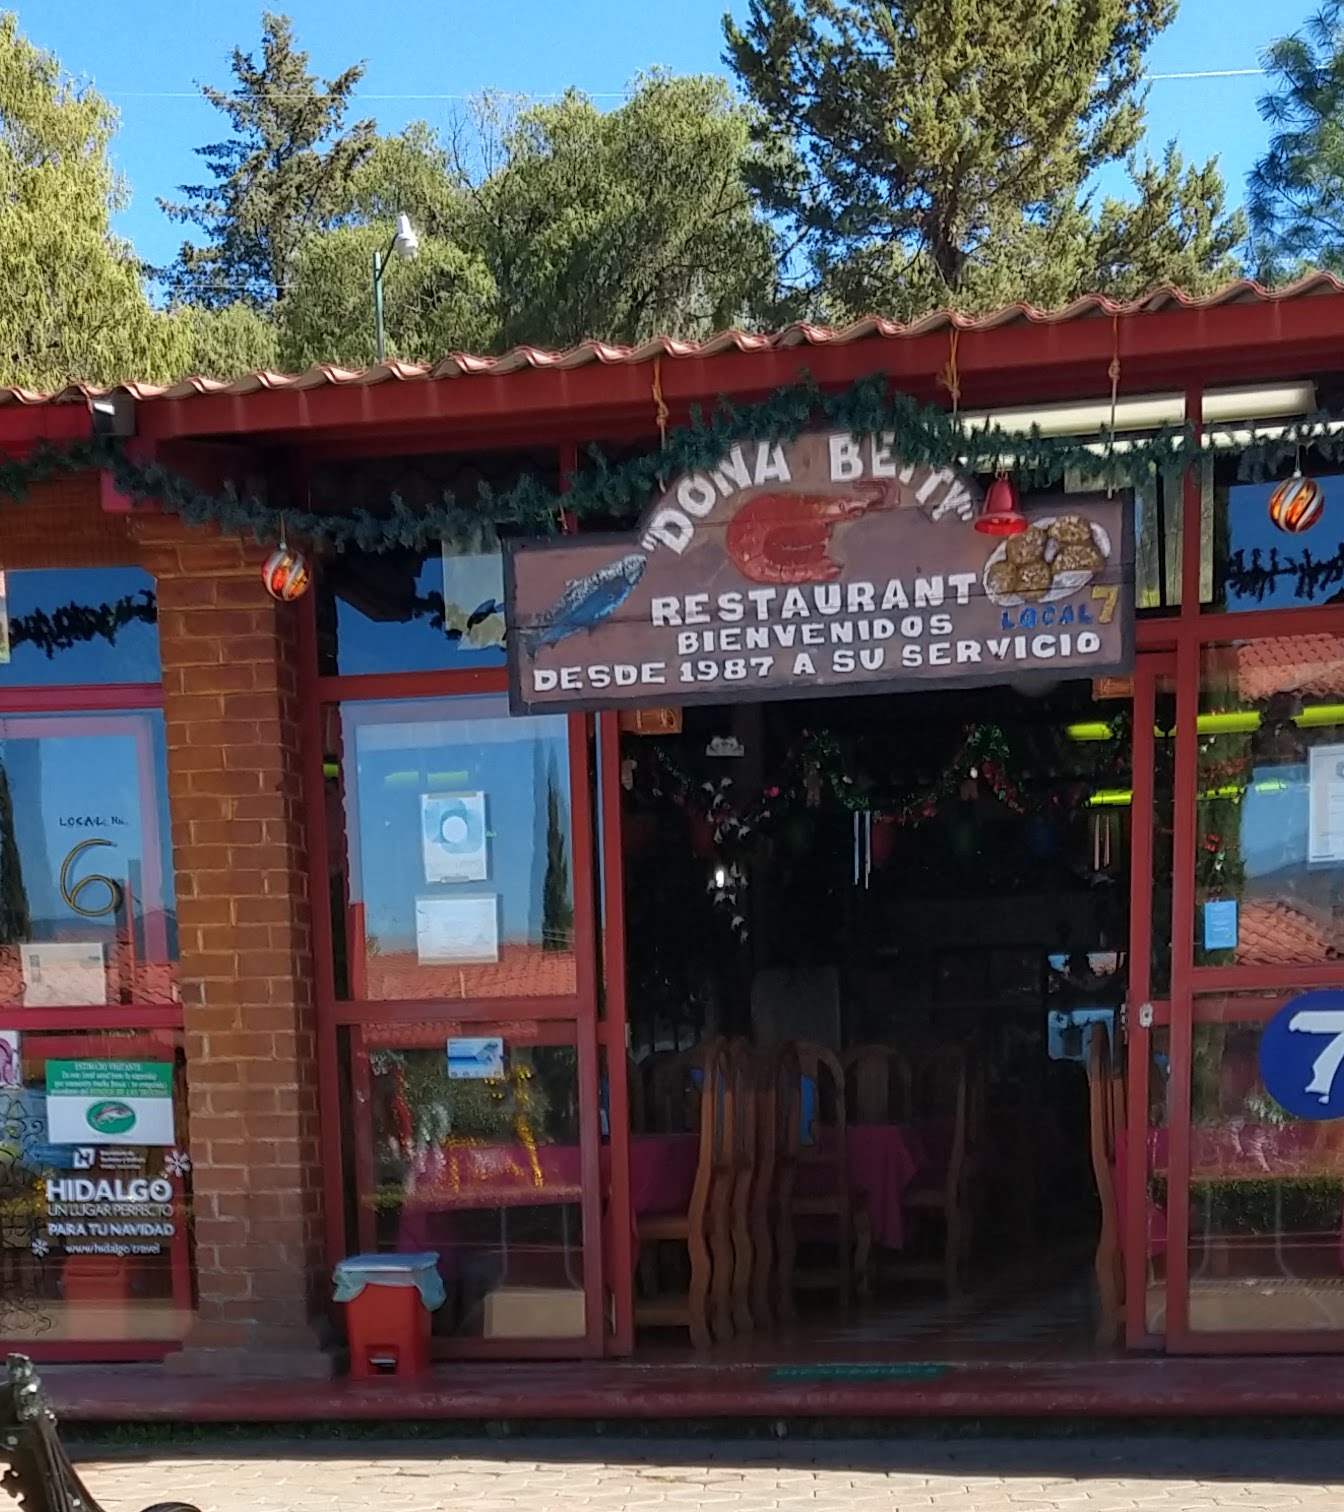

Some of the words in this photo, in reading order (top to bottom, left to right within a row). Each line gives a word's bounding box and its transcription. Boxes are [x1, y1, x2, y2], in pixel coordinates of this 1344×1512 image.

[828, 431, 973, 522] BETY"
[651, 572, 977, 627] RESTAURANT
[1001, 604, 1093, 631] LOCAL
[1090, 586, 1119, 625] 7
[678, 613, 953, 656] BIENVENIDOS
[533, 661, 666, 692] DESDE
[679, 655, 774, 684] 1987
[792, 652, 816, 676] A
[832, 647, 885, 673] SU
[901, 631, 1101, 668] SERVICIO
[59, 816, 104, 827] LOCAL
[60, 838, 118, 918] 6
[47, 1179, 173, 1202] HIDALGO
[48, 1204, 68, 1217] UN
[70, 1204, 112, 1217] LUGAR
[112, 1204, 174, 1217] PERFECTO
[48, 1223, 88, 1237] PARA
[88, 1223, 109, 1236] TU
[110, 1223, 175, 1237] NAVIDAD
